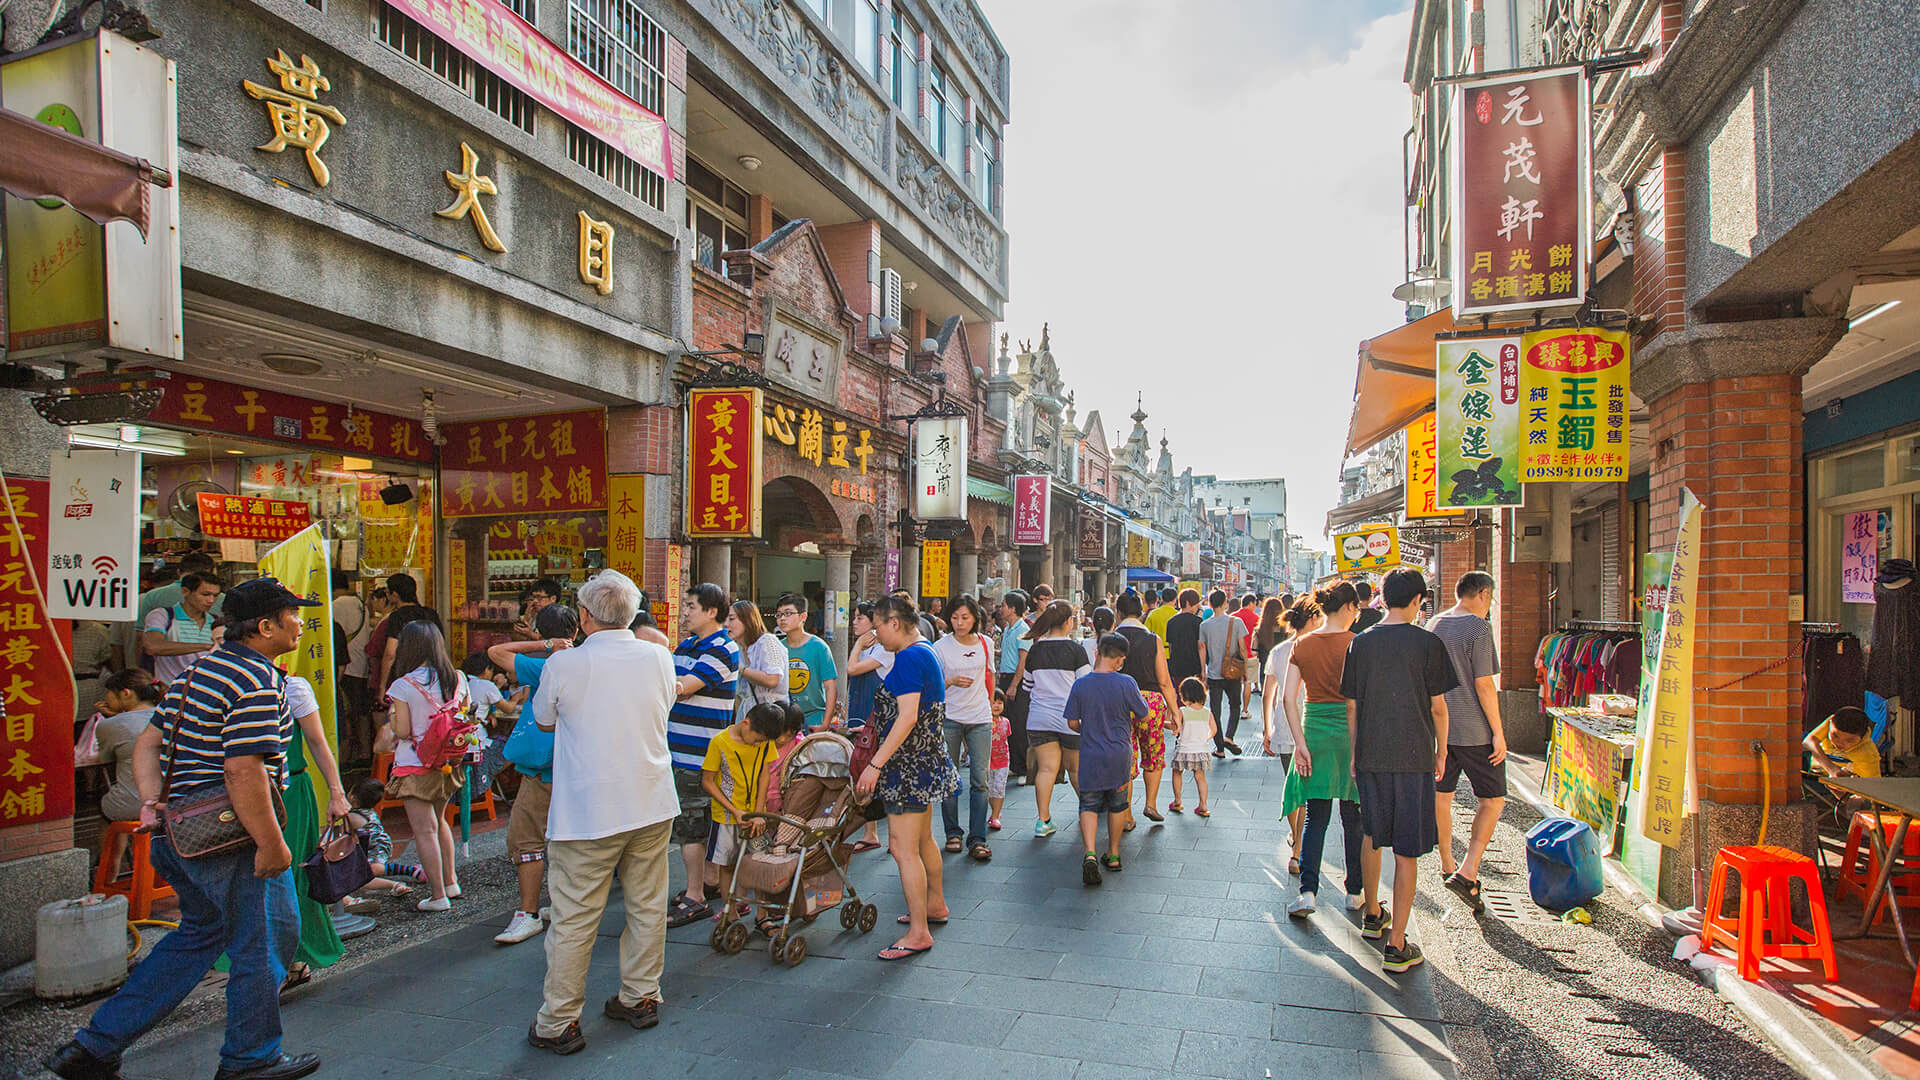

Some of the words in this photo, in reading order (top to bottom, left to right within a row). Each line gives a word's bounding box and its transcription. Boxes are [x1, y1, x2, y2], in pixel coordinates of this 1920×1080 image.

[242, 47, 614, 296] 黃大目
[1497, 85, 1545, 242] 元茂軒
[1470, 271, 1573, 300] 各種漢餅
[1471, 244, 1573, 274] 月光餅
[1502, 345, 1516, 402] 台灣埔里
[1538, 340, 1616, 369] 臻福興
[283, 424, 296, 436] 39
[1456, 350, 1498, 461] 金線蓮
[1528, 386, 1549, 446] 純天然
[1556, 376, 1598, 451] 玉鐲
[1607, 384, 1624, 444] 批發零售
[466, 418, 577, 465] 豆干元祖
[706, 397, 738, 505] 黃大目
[764, 404, 874, 476] 心蘭豆干
[455, 464, 593, 513] 黃大目本舖
[1526, 466, 1624, 479] 0989-310979
[701, 506, 743, 530] 豆干
[63, 577, 128, 608] Wifi
[0, 486, 46, 819] 豆干元祖黃大目本舖
